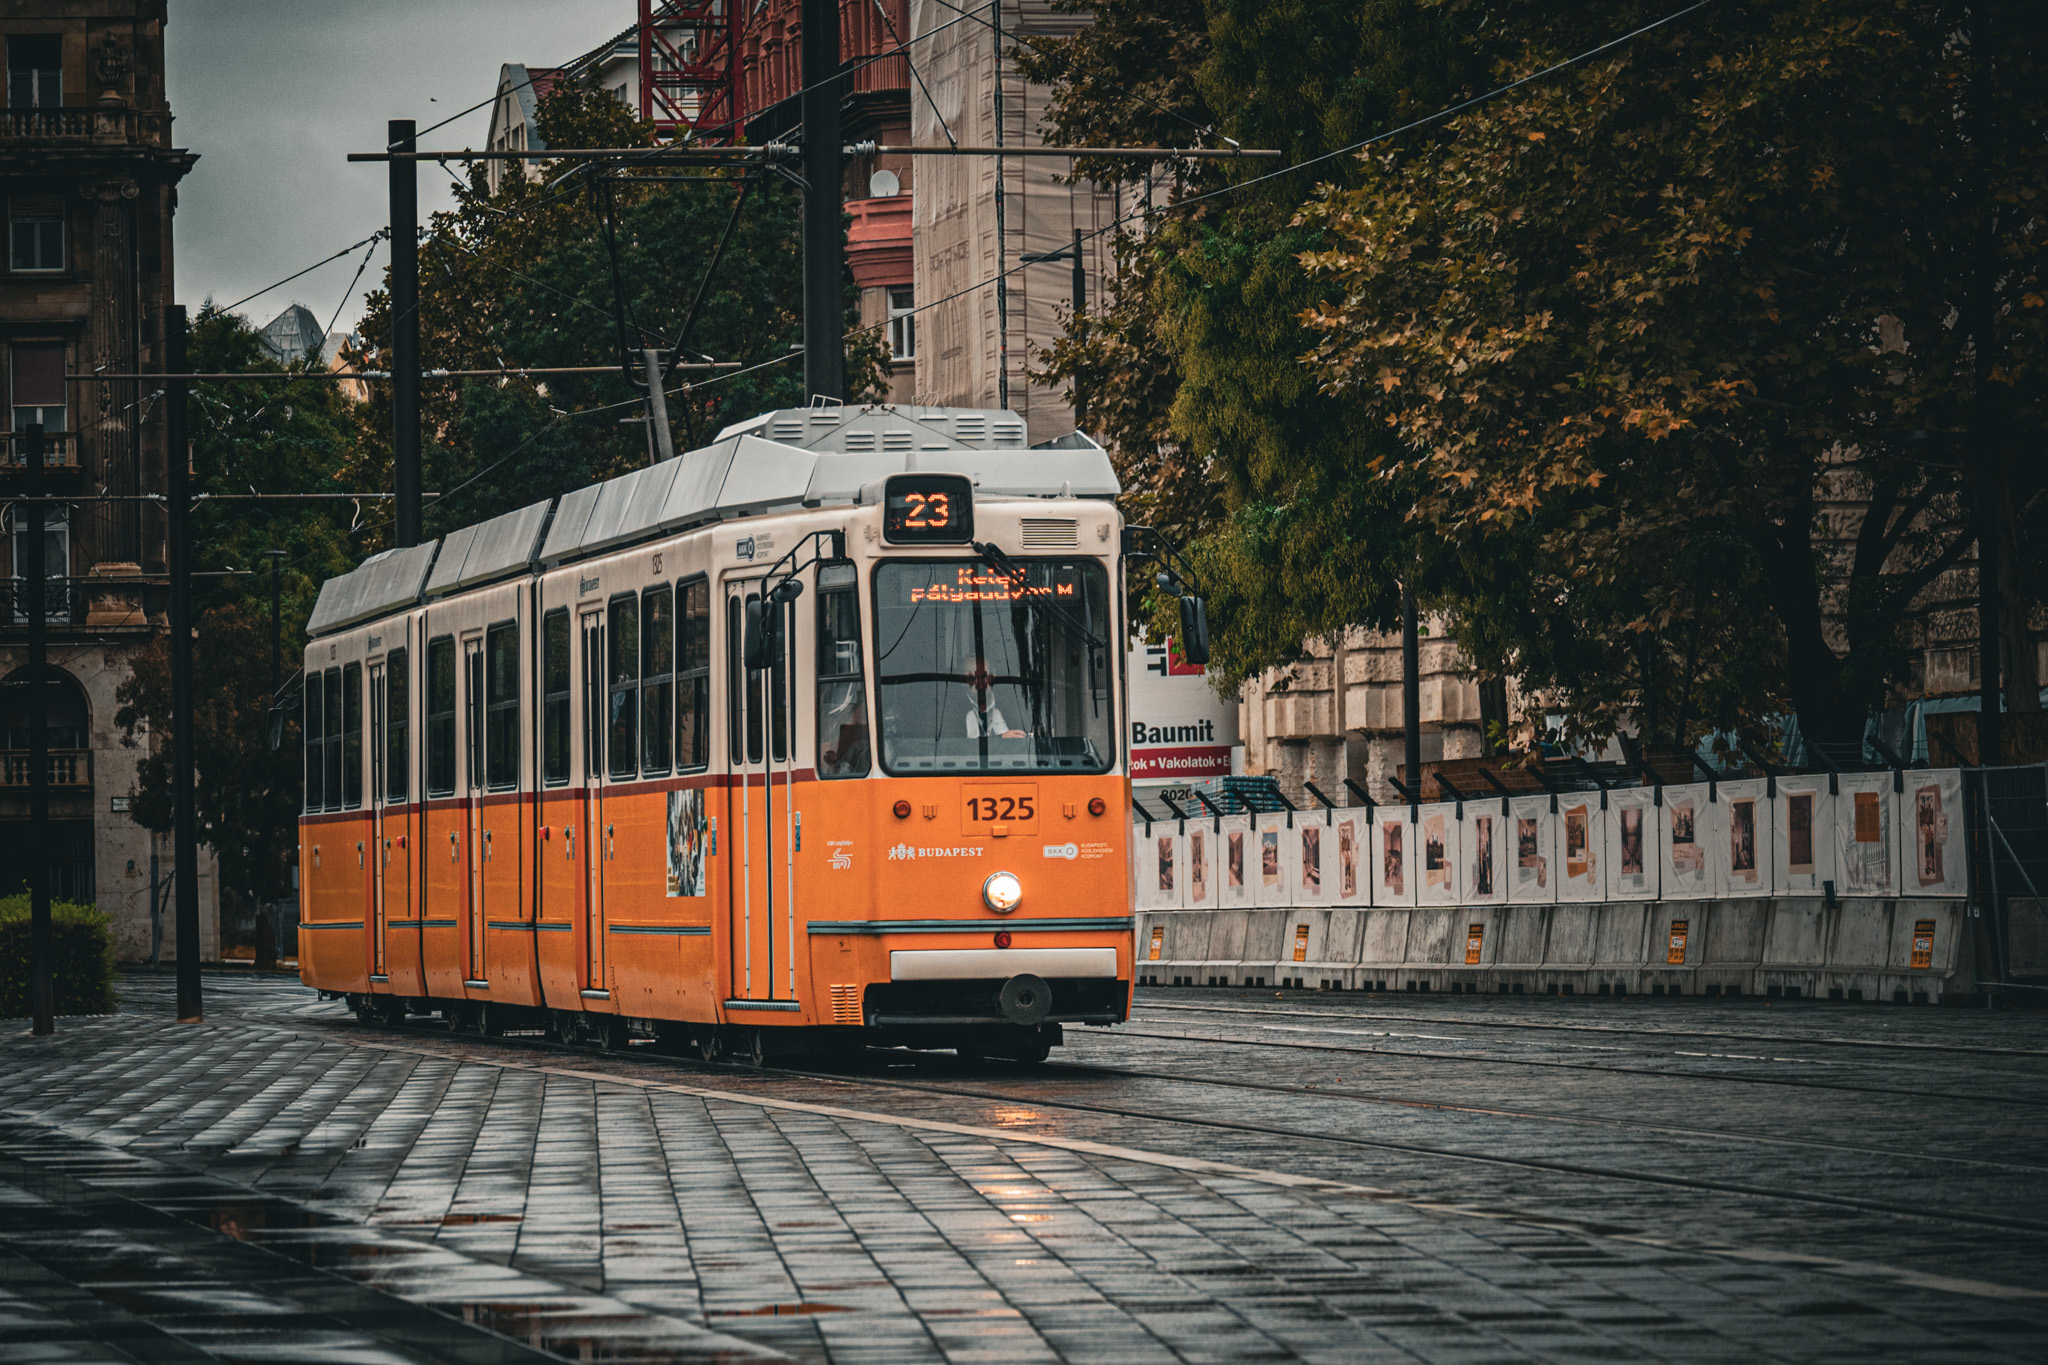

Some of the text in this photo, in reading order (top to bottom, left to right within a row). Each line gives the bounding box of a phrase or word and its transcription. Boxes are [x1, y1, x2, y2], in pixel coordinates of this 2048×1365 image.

[905, 494, 949, 527] 23
[1131, 719, 1214, 745] Baumit
[1158, 755, 1216, 769] Vakolatok
[967, 797, 1034, 821] 1325
[918, 847, 984, 857] BUDAPEST
